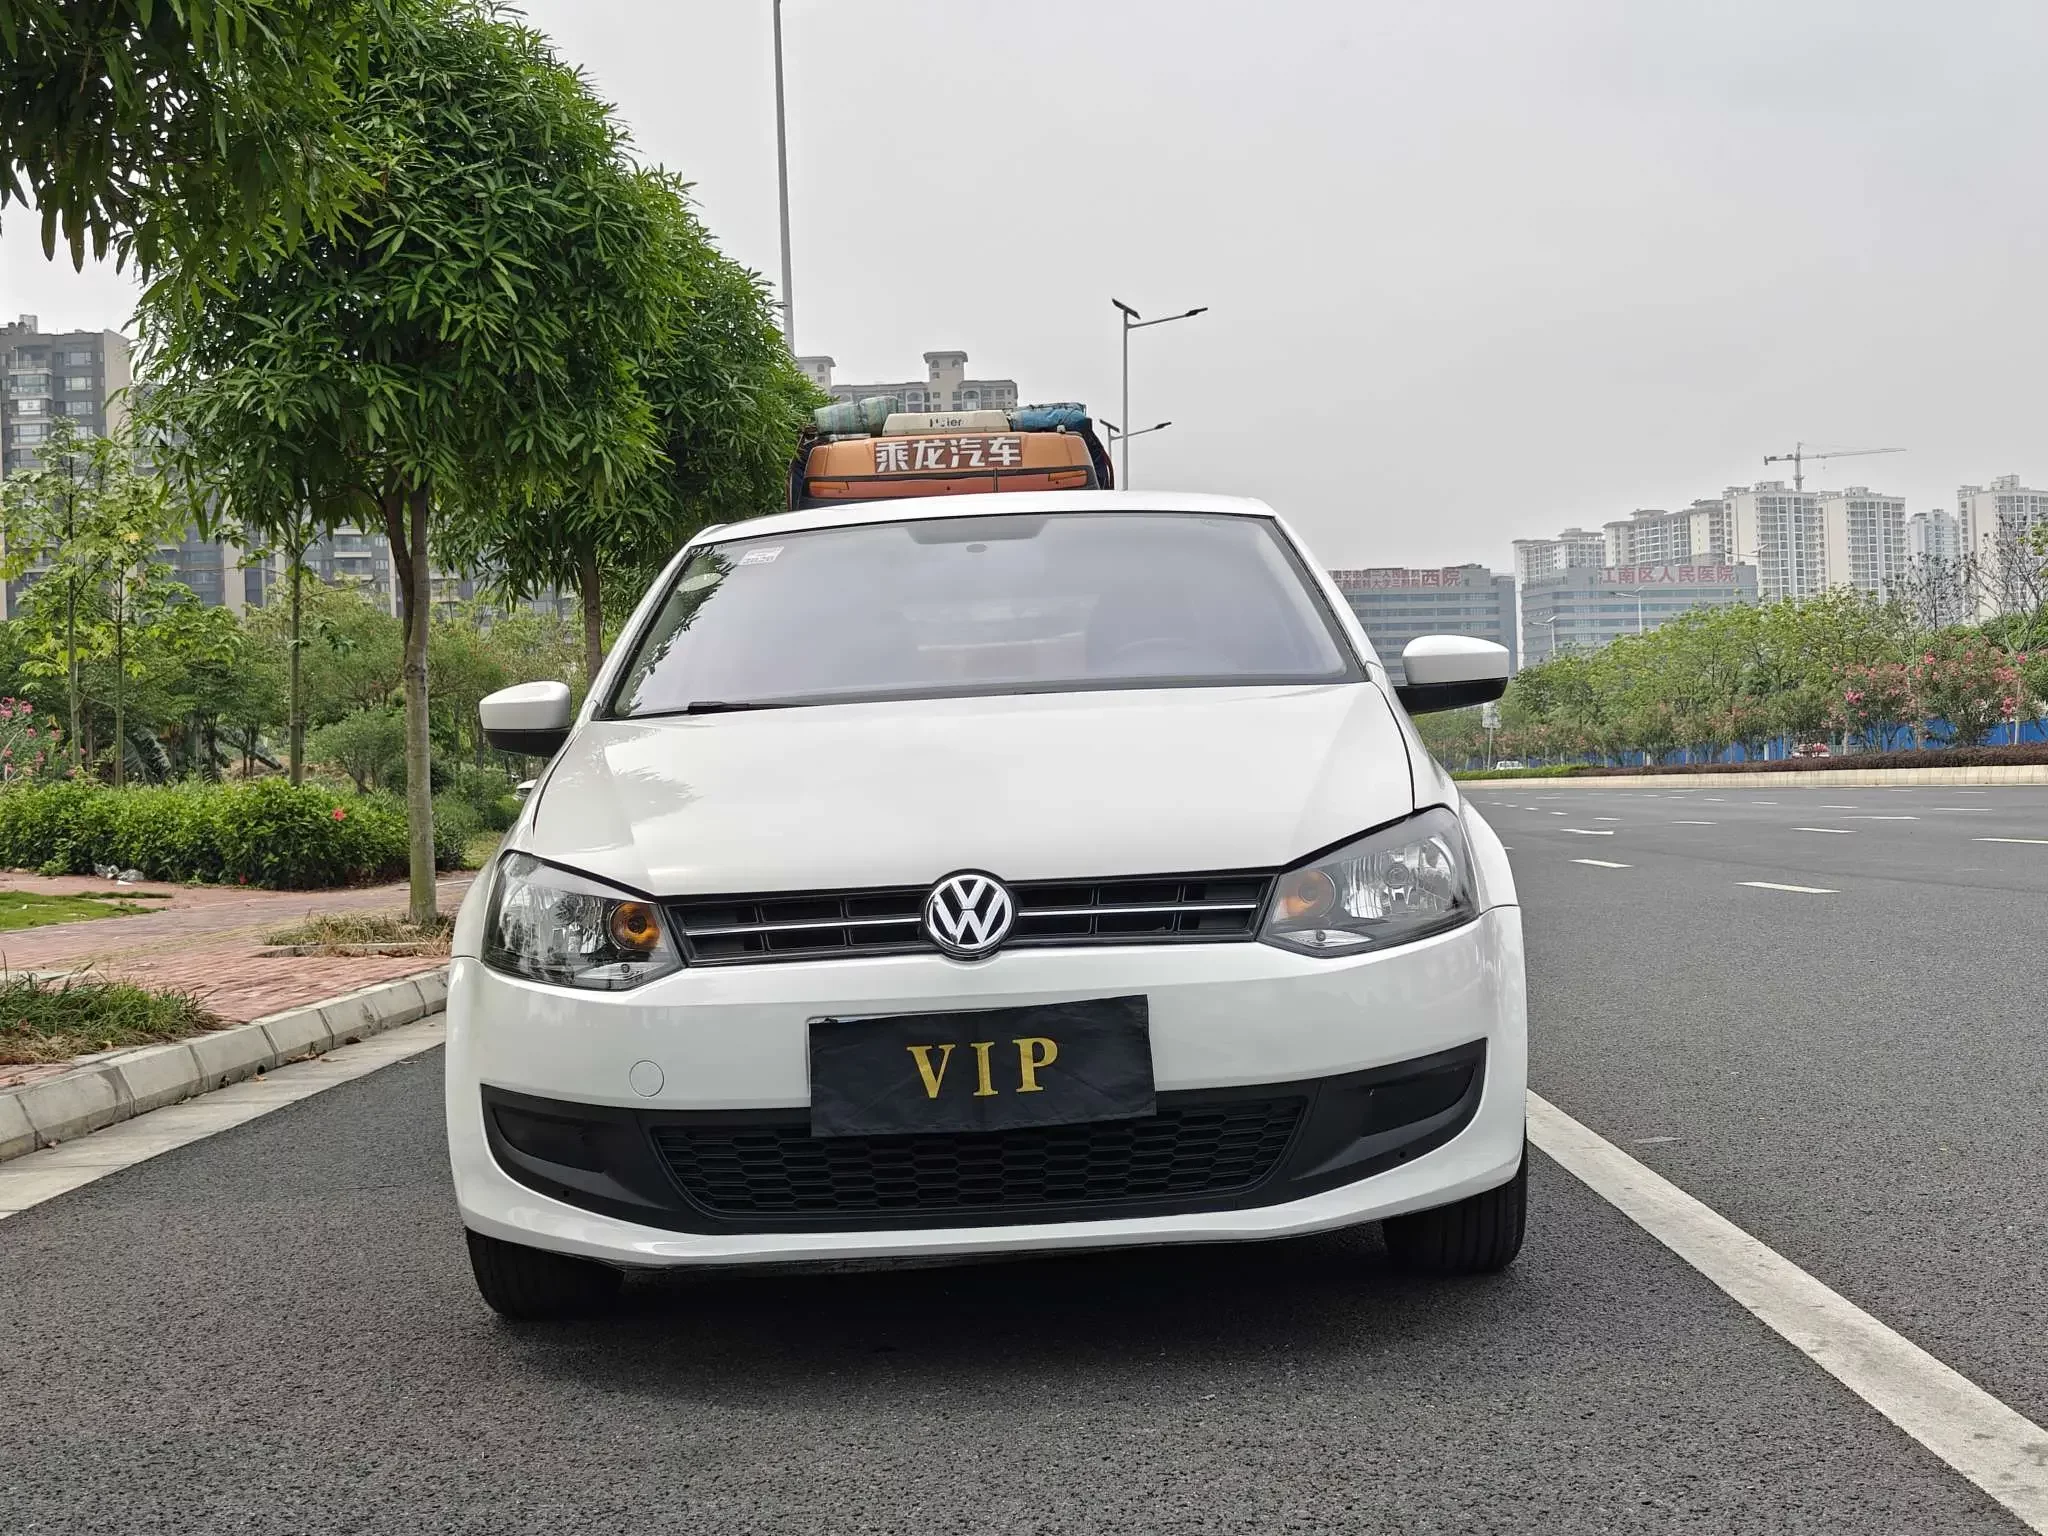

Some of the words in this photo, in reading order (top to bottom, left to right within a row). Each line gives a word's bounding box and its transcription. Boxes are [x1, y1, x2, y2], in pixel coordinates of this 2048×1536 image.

[875, 436, 1022, 473] 乘龙汽车
[1598, 565, 1735, 584] 江南区人民医院
[906, 1036, 1059, 1099] VIP
